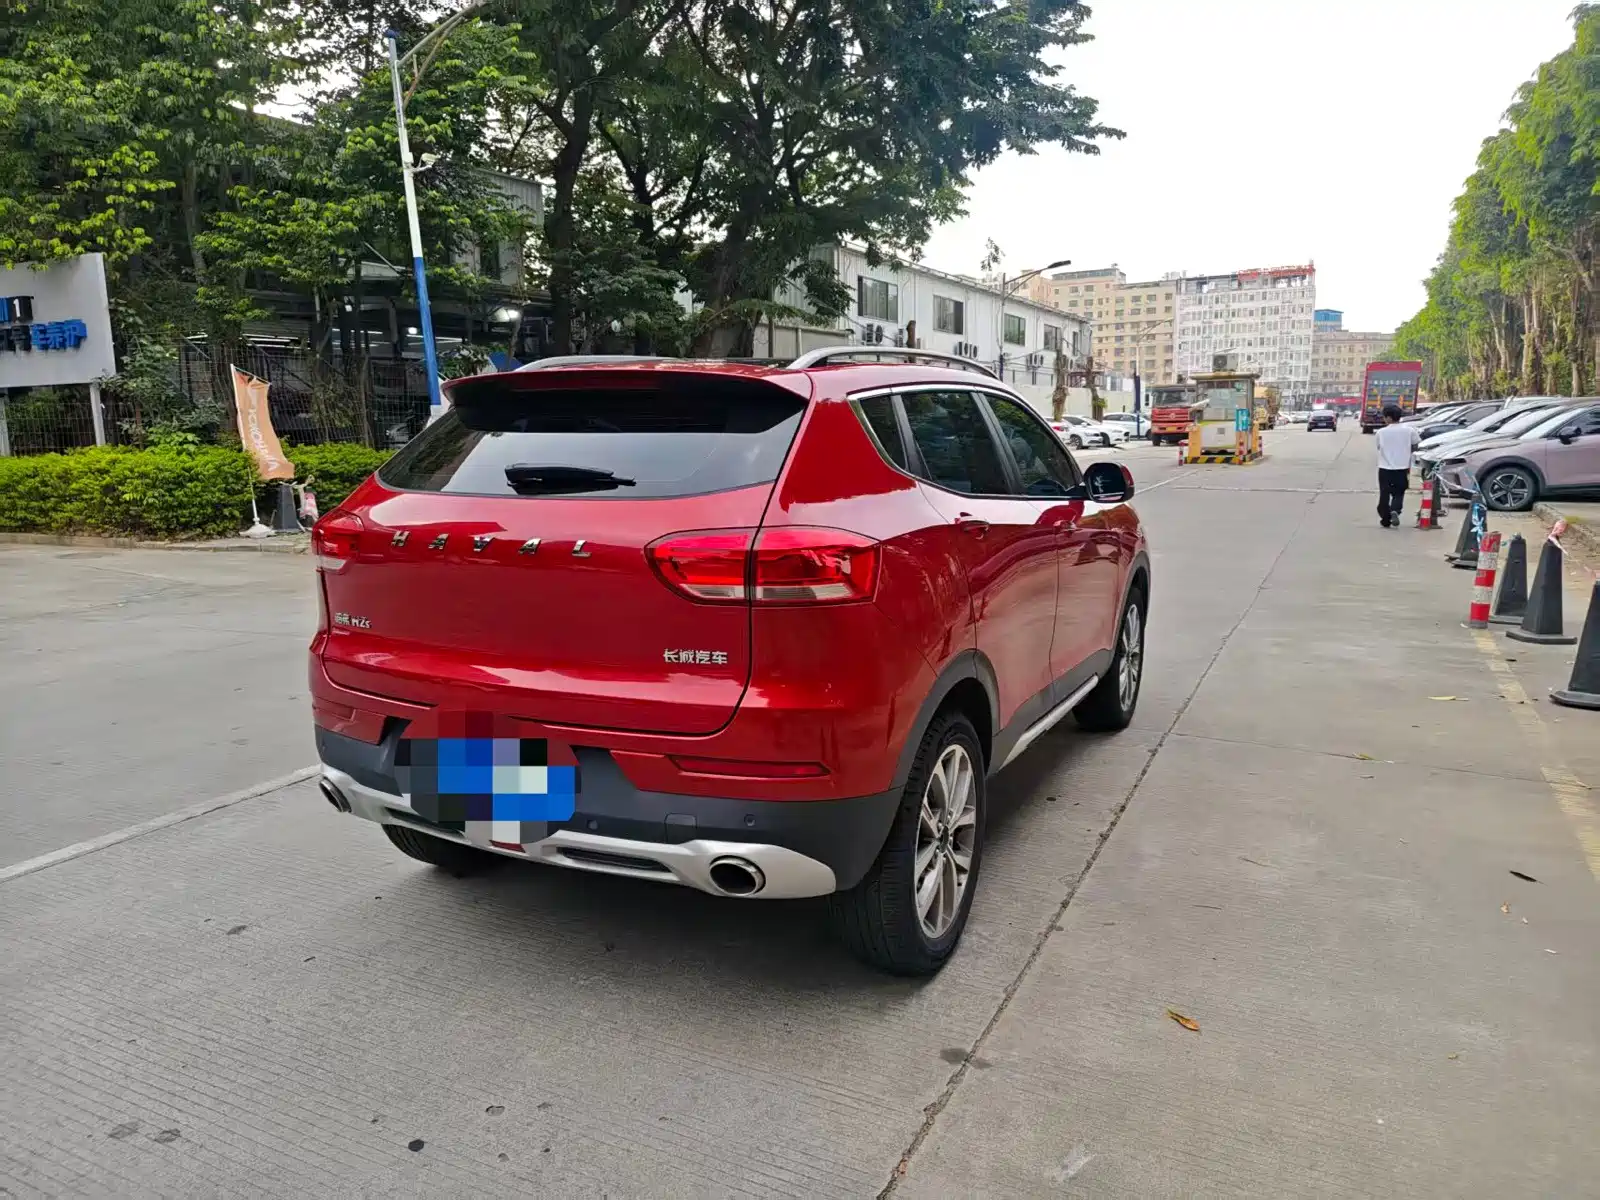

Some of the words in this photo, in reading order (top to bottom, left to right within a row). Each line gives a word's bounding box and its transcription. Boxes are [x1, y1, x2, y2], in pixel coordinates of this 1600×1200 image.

[391, 530, 592, 558] HAVAL
[663, 648, 728, 665] 长城汽车
